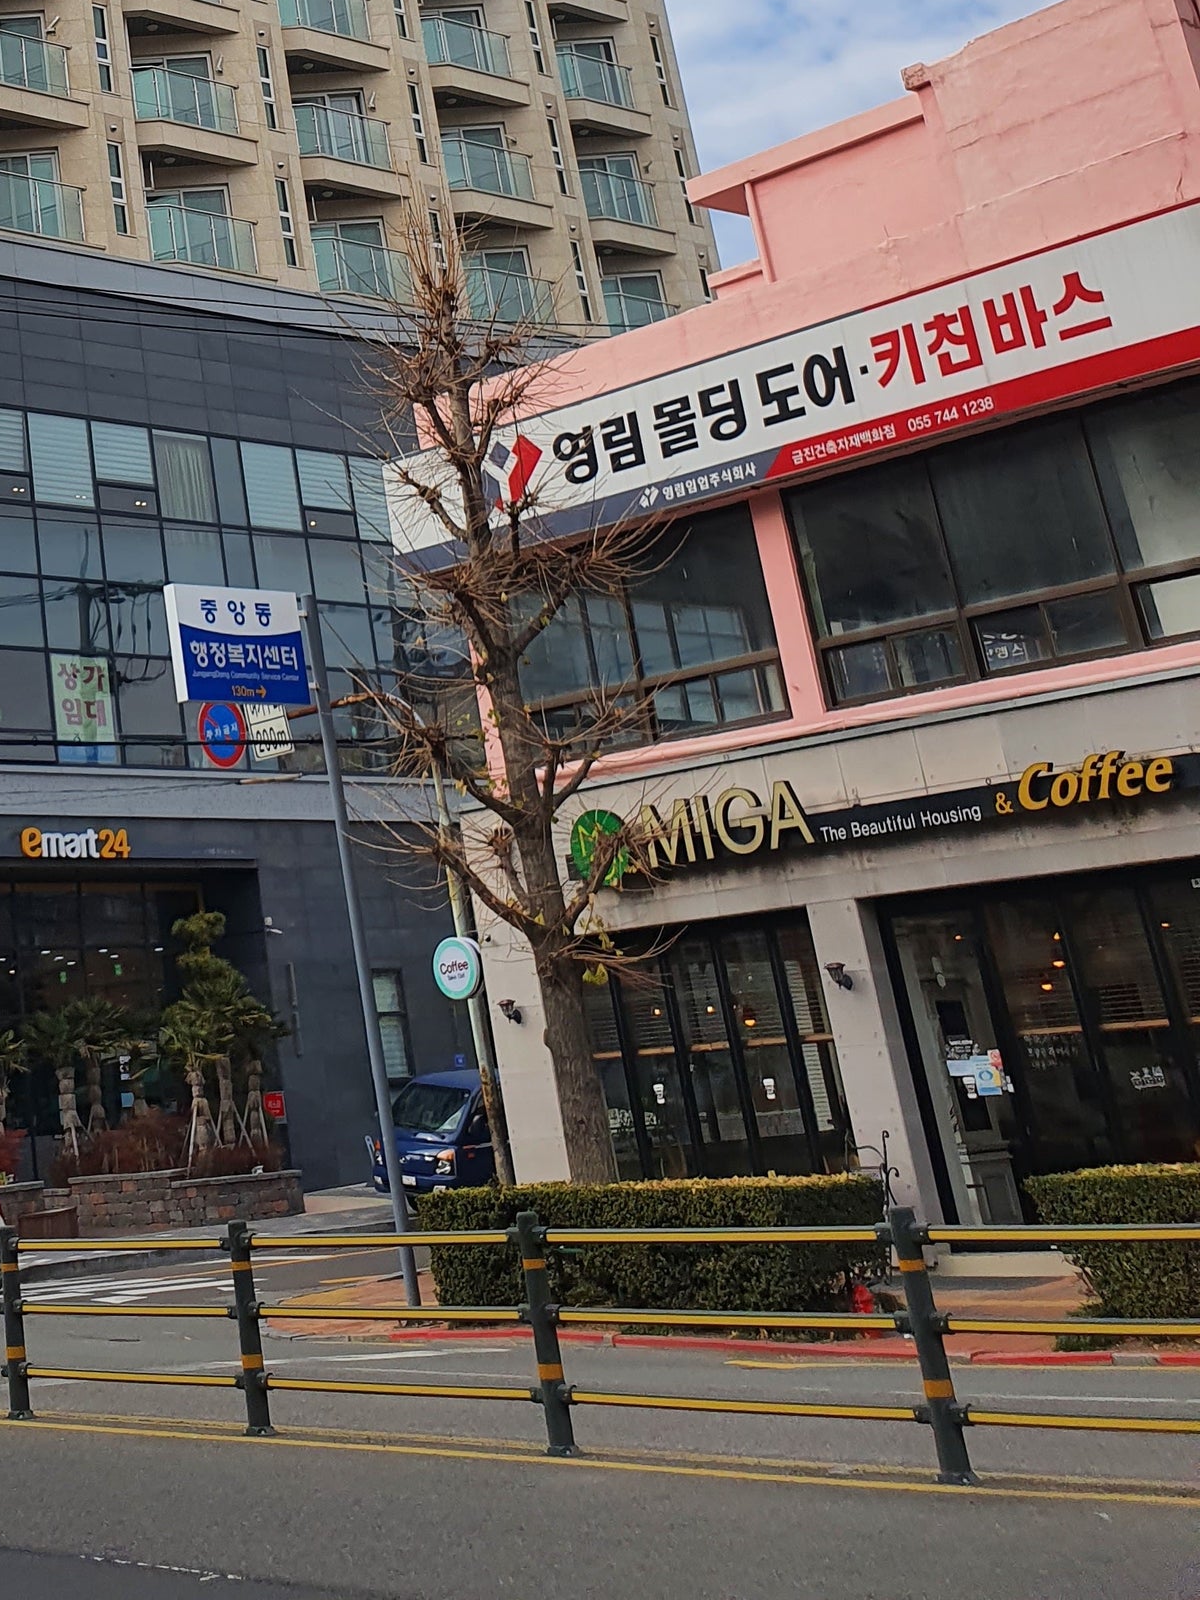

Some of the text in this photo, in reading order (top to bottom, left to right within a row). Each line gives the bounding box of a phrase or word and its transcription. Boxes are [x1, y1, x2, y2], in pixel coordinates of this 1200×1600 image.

[552, 411, 646, 484] 영림
[653, 379, 747, 459] 몰딩
[791, 396, 994, 465] 금진건축자재백화점 055 744 1238
[190, 640, 298, 670] 행정복지센터
[57, 662, 105, 691] 상가
[231, 685, 255, 697] 130m
[61, 698, 106, 726] 임대
[256, 727, 288, 753] 200m
[641, 751, 1174, 868] MIGA The Beautiful Housing & Coffee
[20, 827, 131, 858] emart24
[440, 960, 469, 975] Coffee
